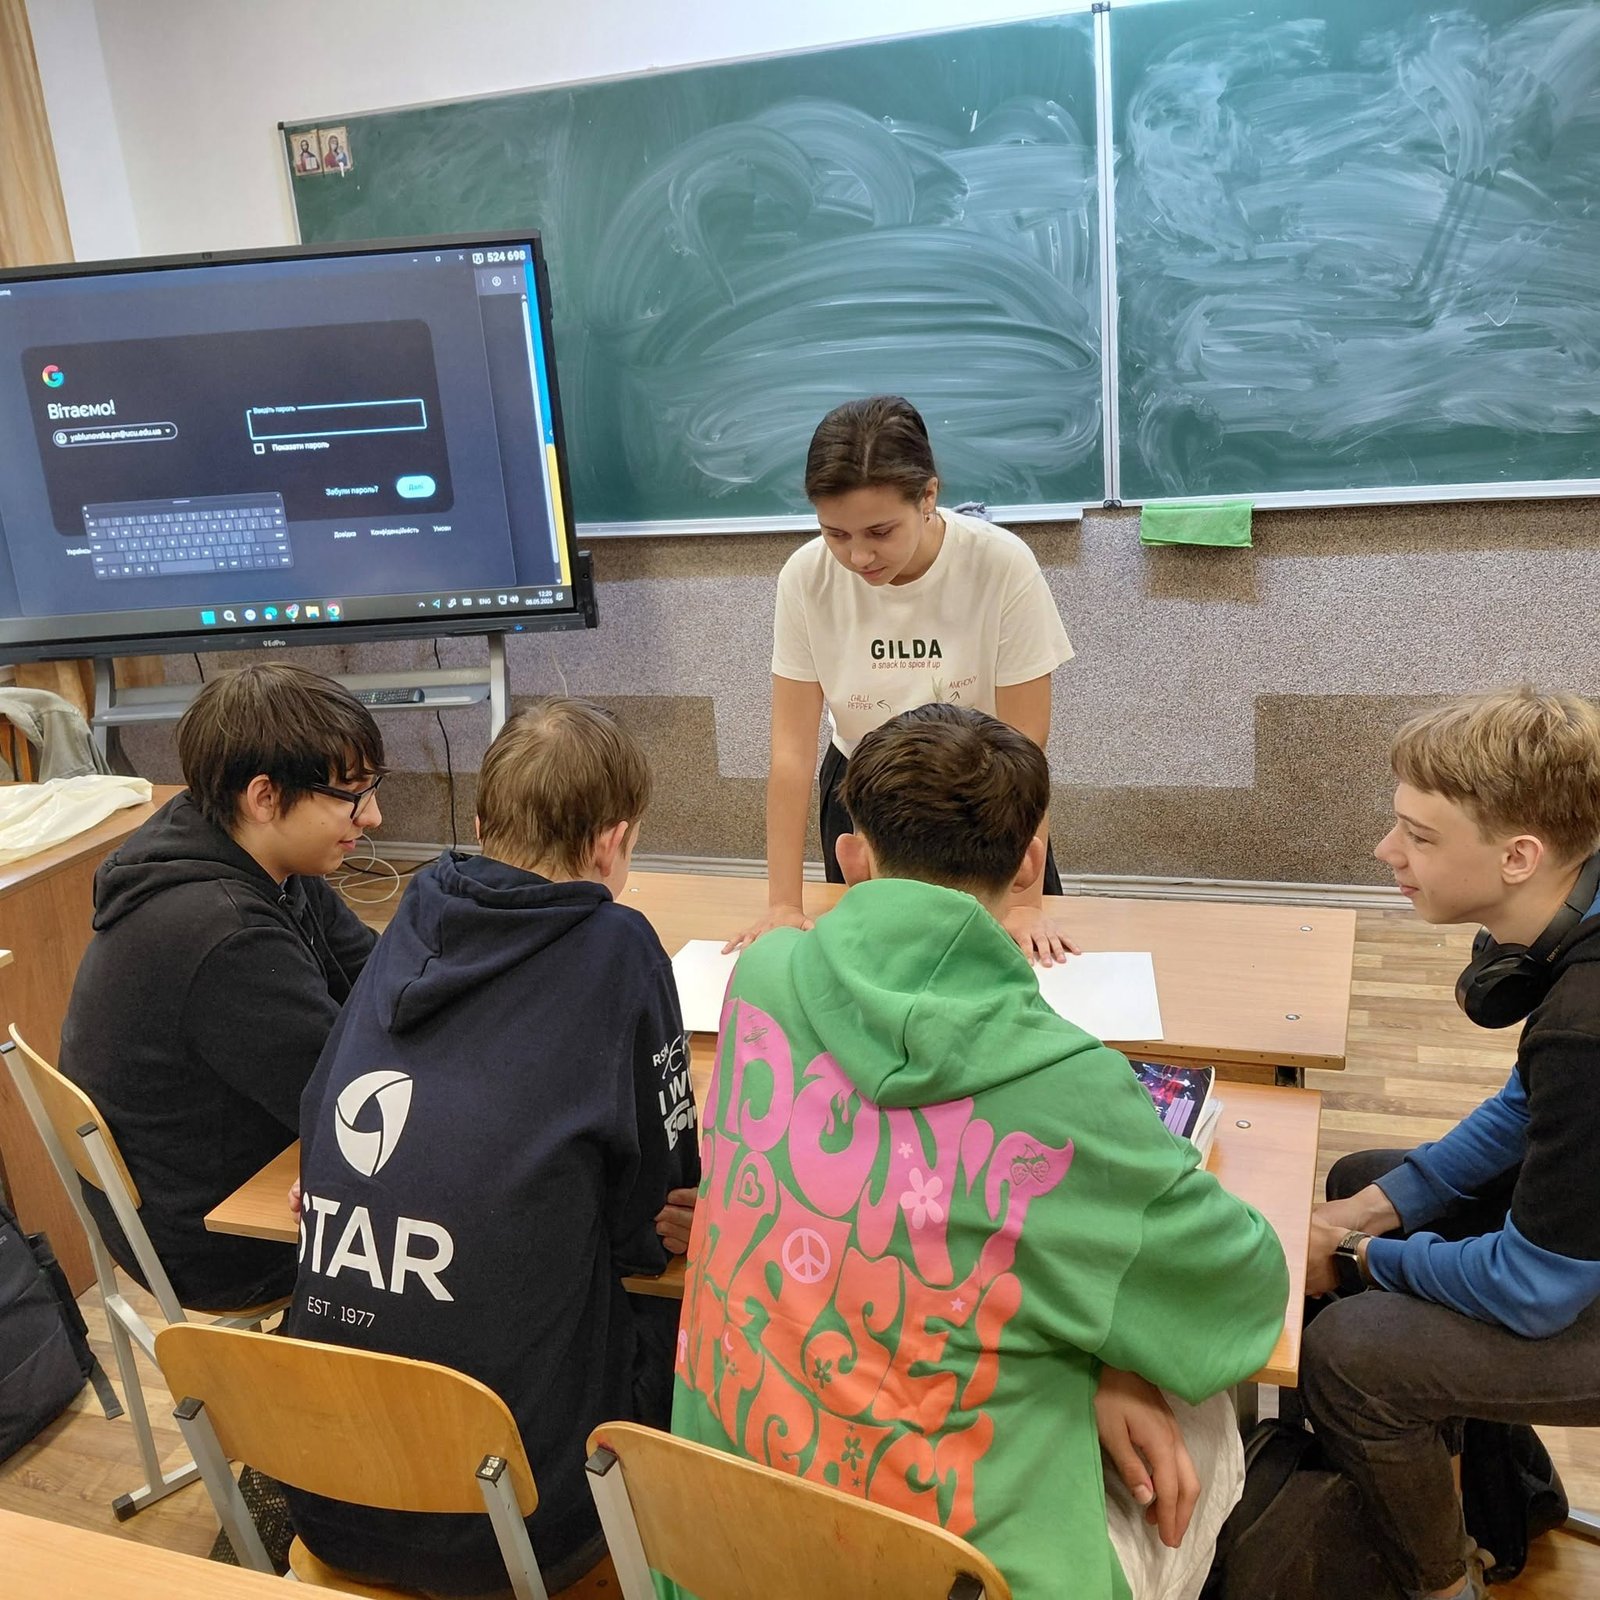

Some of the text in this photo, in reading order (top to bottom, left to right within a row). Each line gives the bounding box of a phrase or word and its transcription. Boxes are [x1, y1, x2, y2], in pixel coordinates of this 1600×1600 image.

[487, 250, 526, 262] 524 698
[47, 399, 116, 419] Вітаємо!
[271, 441, 330, 452] Показати пароль
[325, 485, 379, 497] Забули пароль?
[870, 639, 943, 660] GILDA
[871, 662, 877, 670] a
[877, 659, 898, 669] snack
[899, 660, 907, 669] to
[908, 659, 926, 669] spice
[932, 659, 941, 669] up
[299, 1191, 455, 1302] TAR
[340, 1305, 376, 1328] 1977
